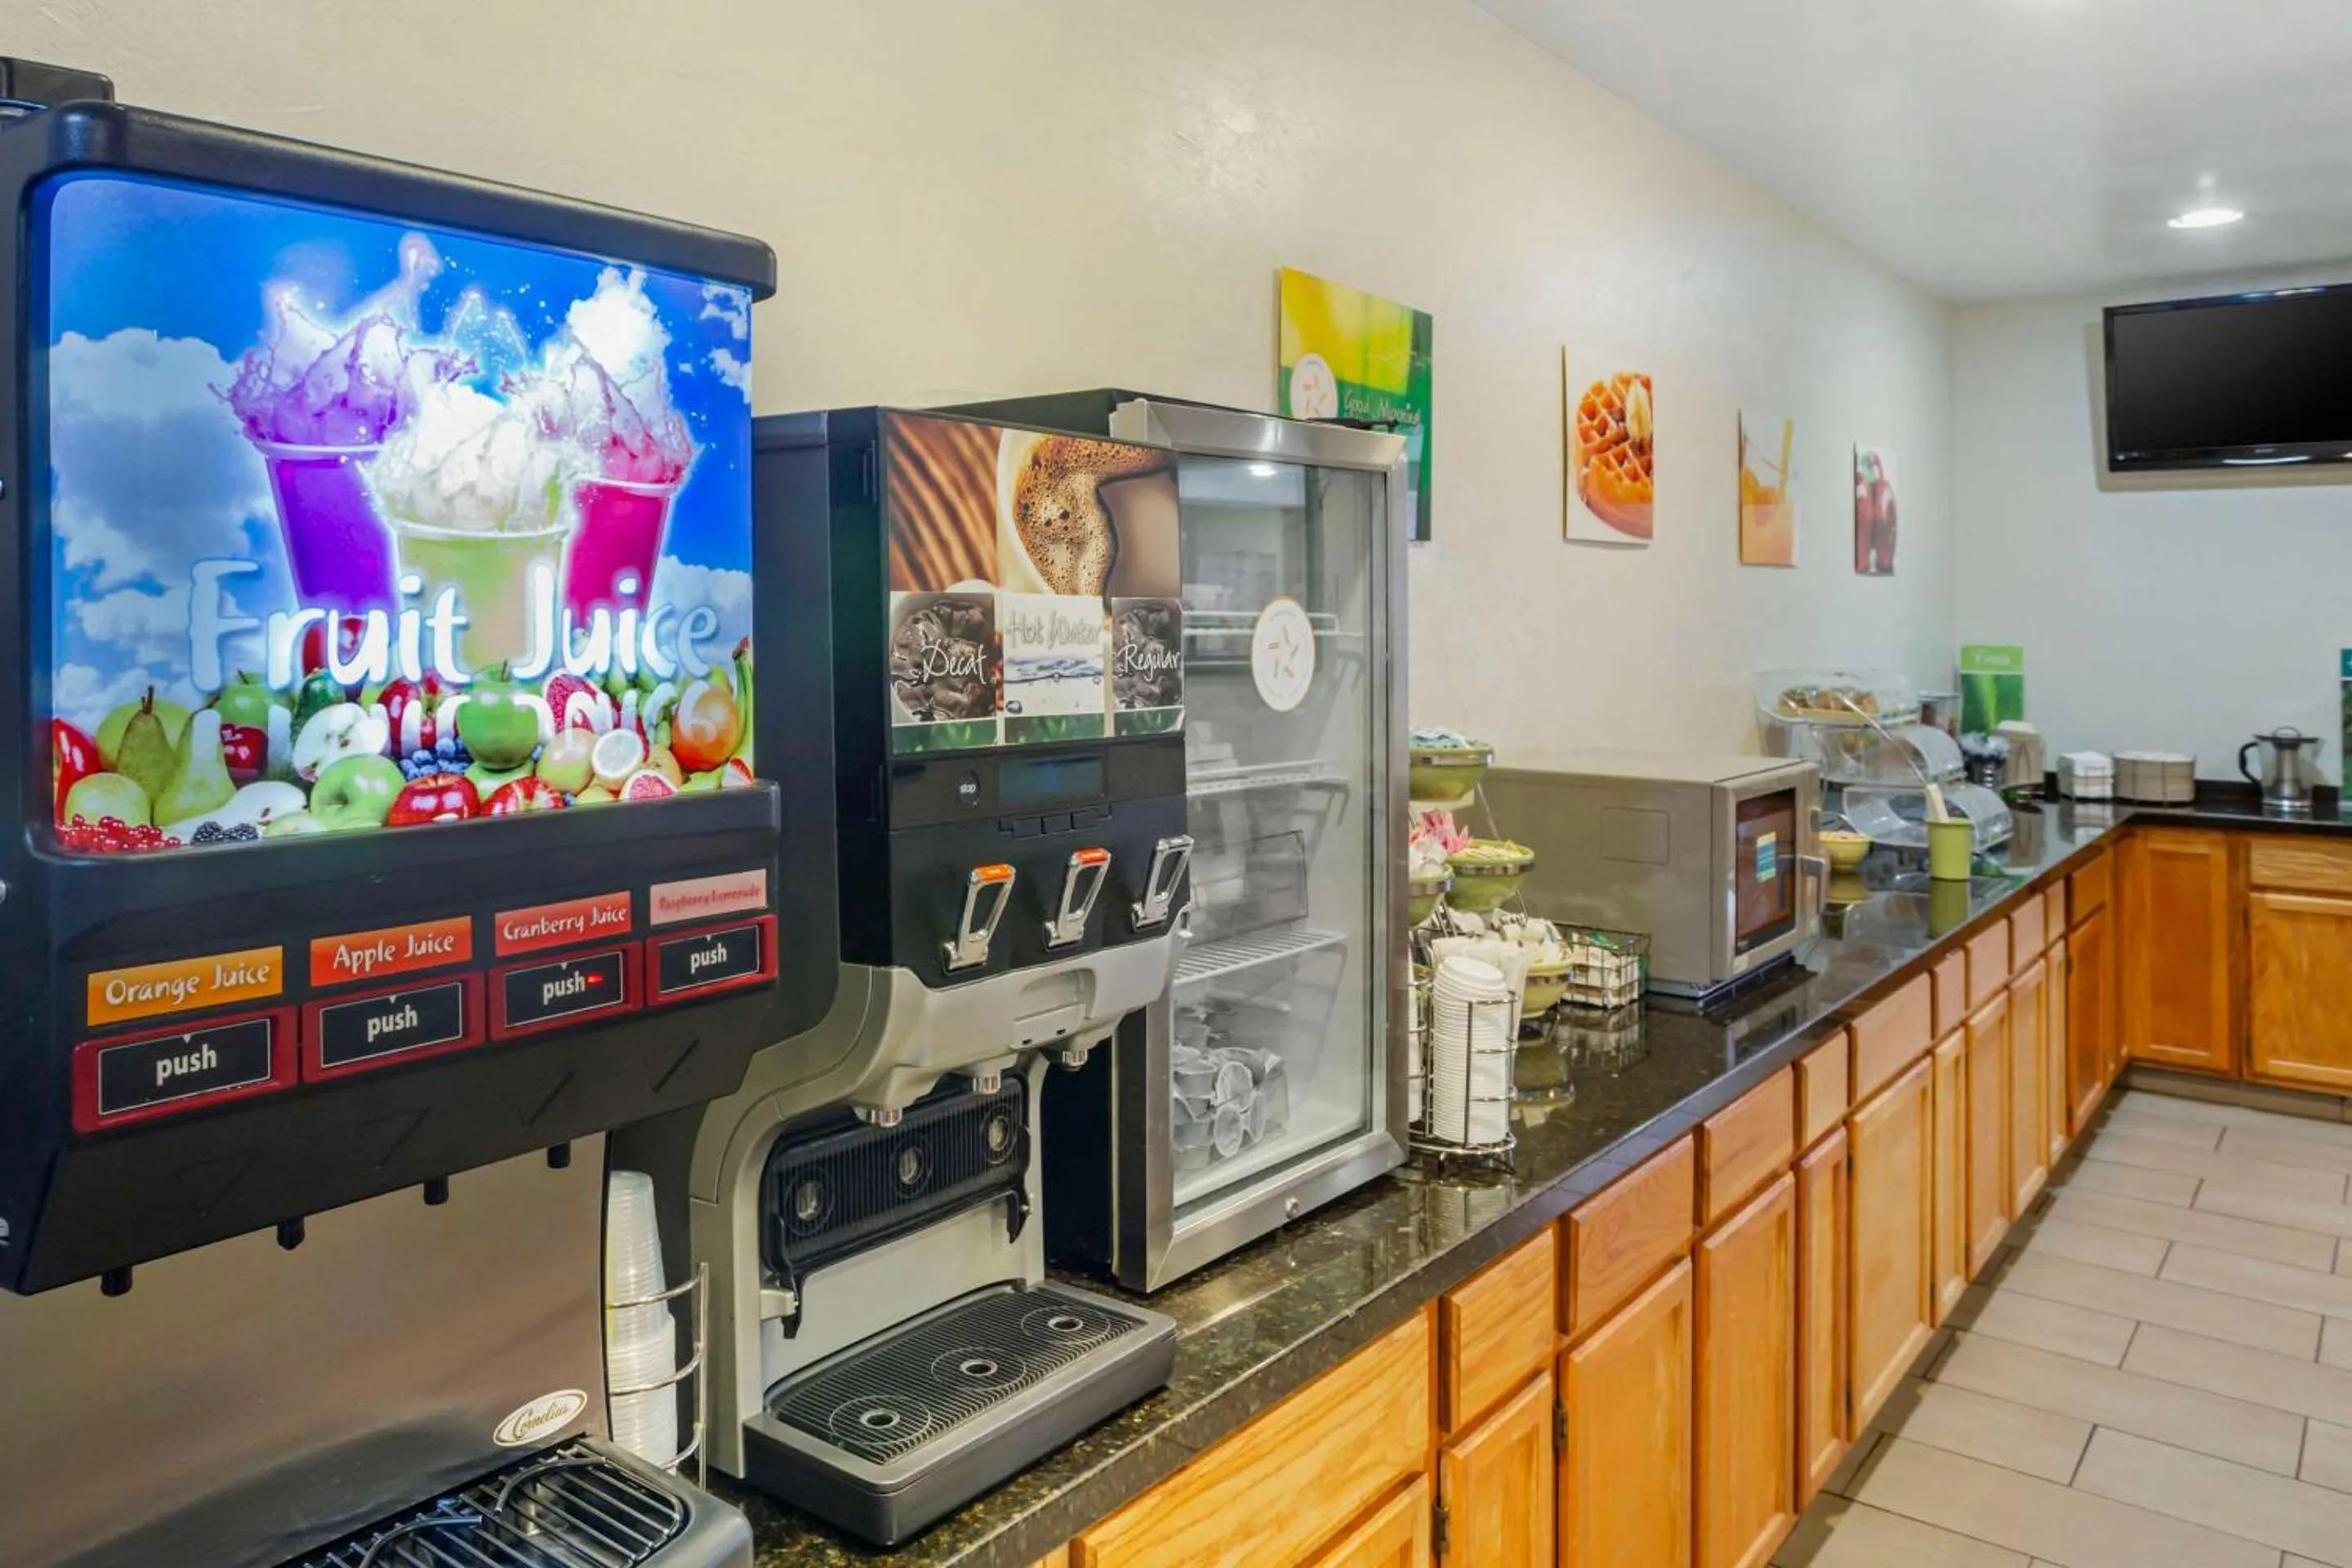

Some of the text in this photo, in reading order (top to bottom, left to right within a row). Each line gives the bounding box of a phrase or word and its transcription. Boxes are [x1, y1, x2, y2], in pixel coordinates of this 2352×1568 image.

[189, 559, 718, 691] Fruit Juice
[1007, 612, 1101, 650] Hot Water
[1113, 644, 1180, 682] Regular
[503, 903, 627, 941] Cranberry Juice
[333, 933, 455, 974] Apple Juice
[691, 942, 727, 974] push
[105, 962, 270, 1006] Orange Juice
[543, 970, 586, 1005] push
[368, 1004, 418, 1043] push
[156, 1043, 218, 1086] push
[513, 1401, 569, 1439] Cornelius
